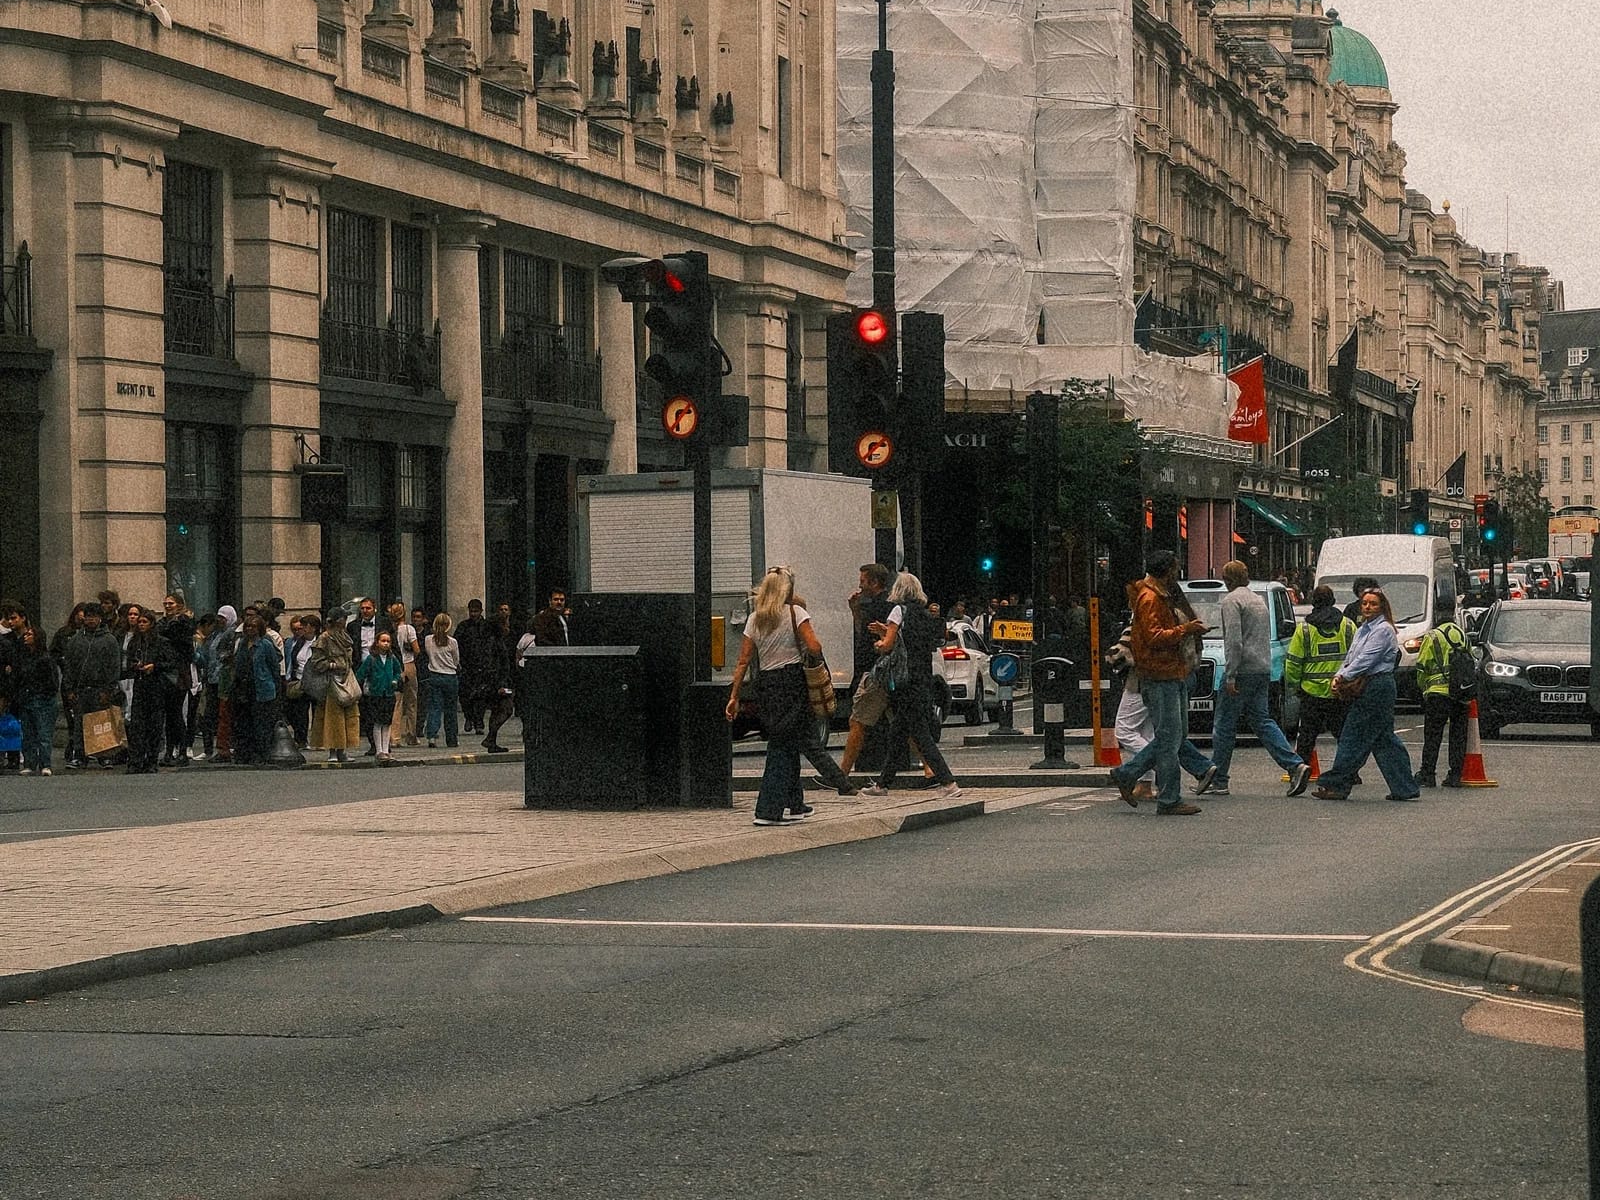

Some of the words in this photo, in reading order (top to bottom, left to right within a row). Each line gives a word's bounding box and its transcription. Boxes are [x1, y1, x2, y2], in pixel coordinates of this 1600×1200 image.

[1230, 407, 1263, 427] amleys
[1447, 482, 1464, 495] alo
[1566, 693, 1583, 701] PTU
